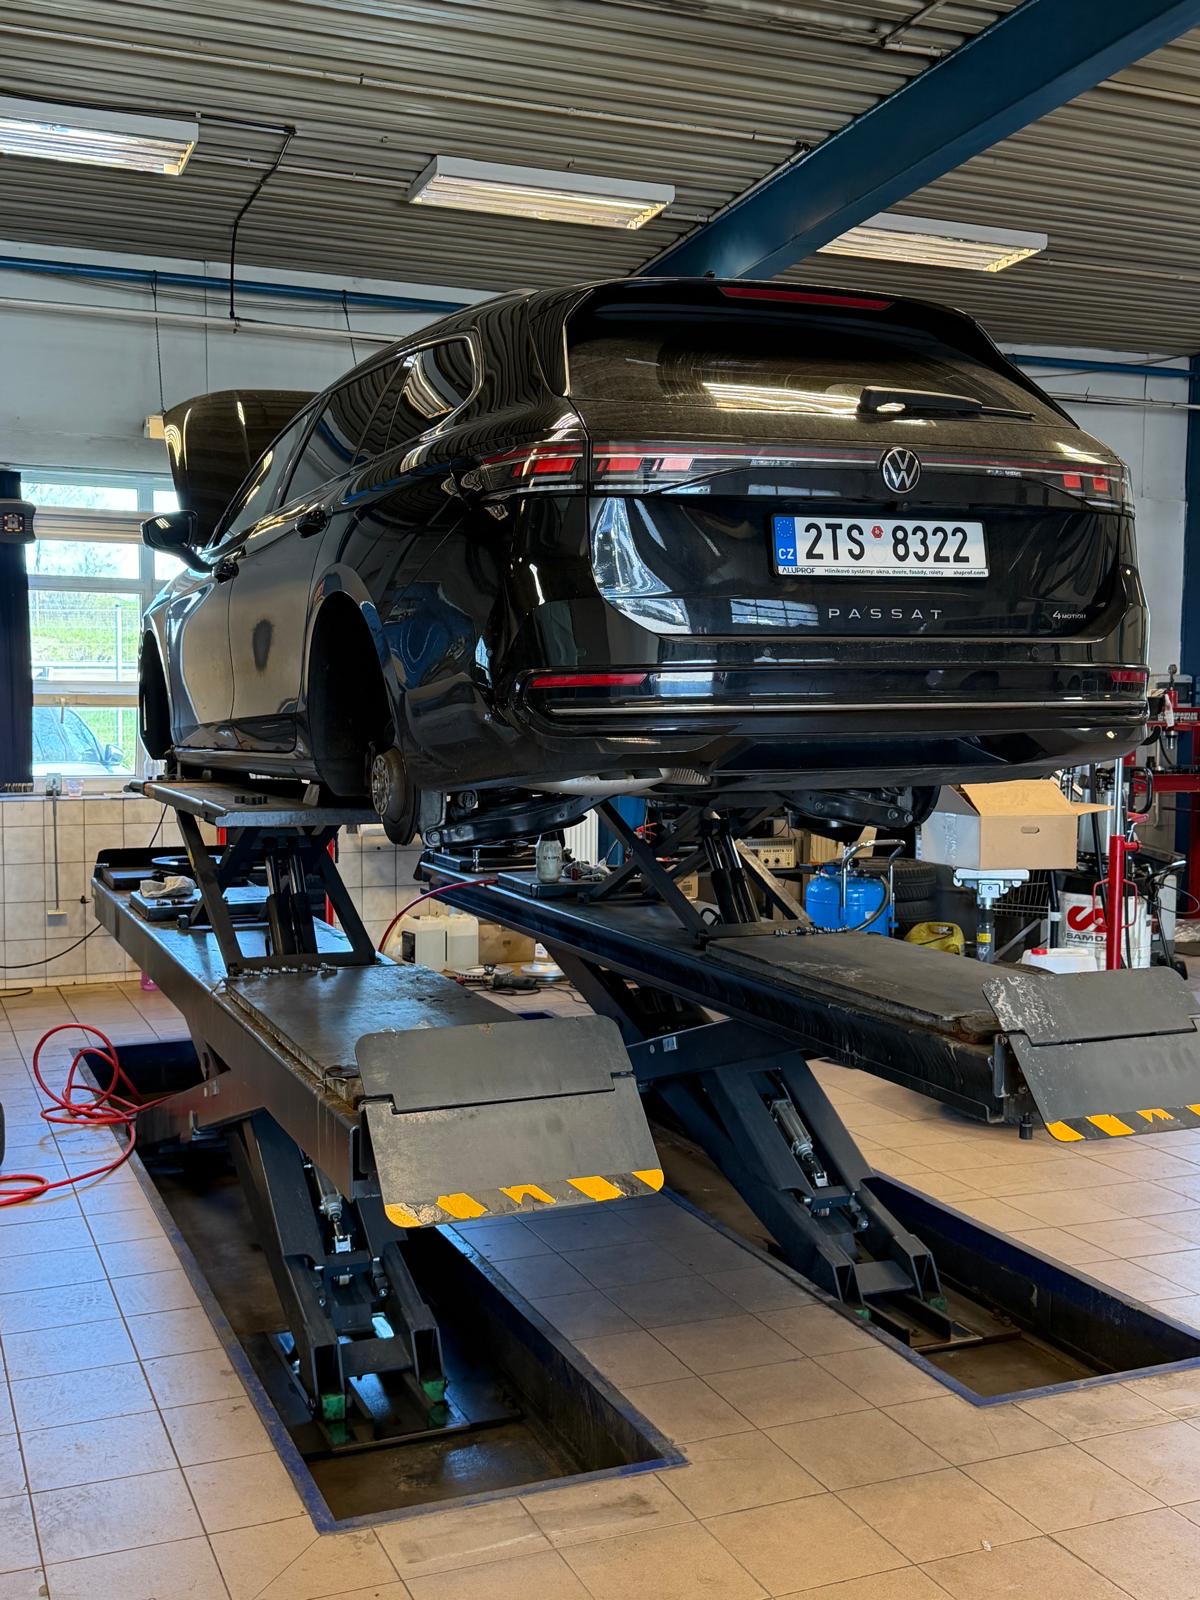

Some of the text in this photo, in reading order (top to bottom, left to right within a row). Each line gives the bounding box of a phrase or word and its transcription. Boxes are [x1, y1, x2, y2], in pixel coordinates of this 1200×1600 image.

[804, 522, 970, 563] 2TS 8322
[778, 548, 795, 560] CZ
[828, 608, 942, 619] PASSAT
[1052, 610, 1087, 620] 4MOTION
